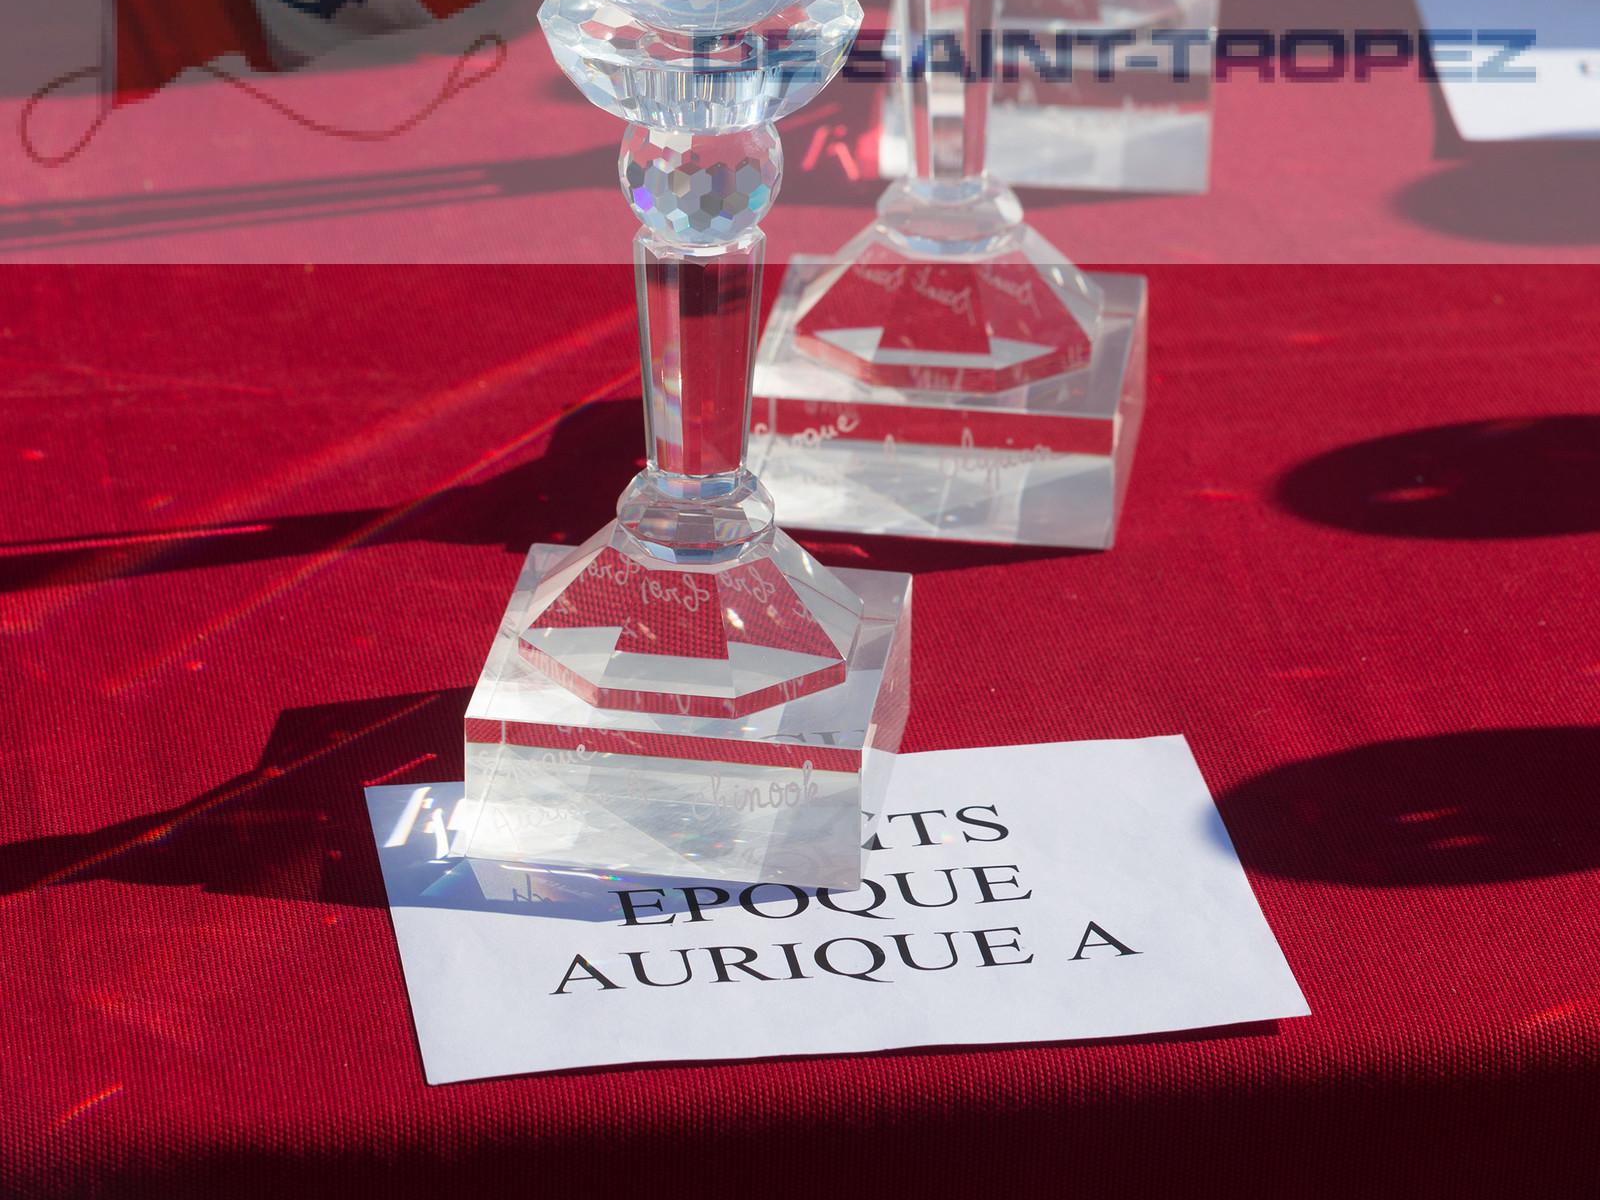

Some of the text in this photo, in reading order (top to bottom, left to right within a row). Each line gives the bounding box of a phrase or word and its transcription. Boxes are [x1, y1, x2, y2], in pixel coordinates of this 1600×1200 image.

[609, 865, 1033, 926] EPOQUE
[549, 921, 1144, 994] AURIQUE A
